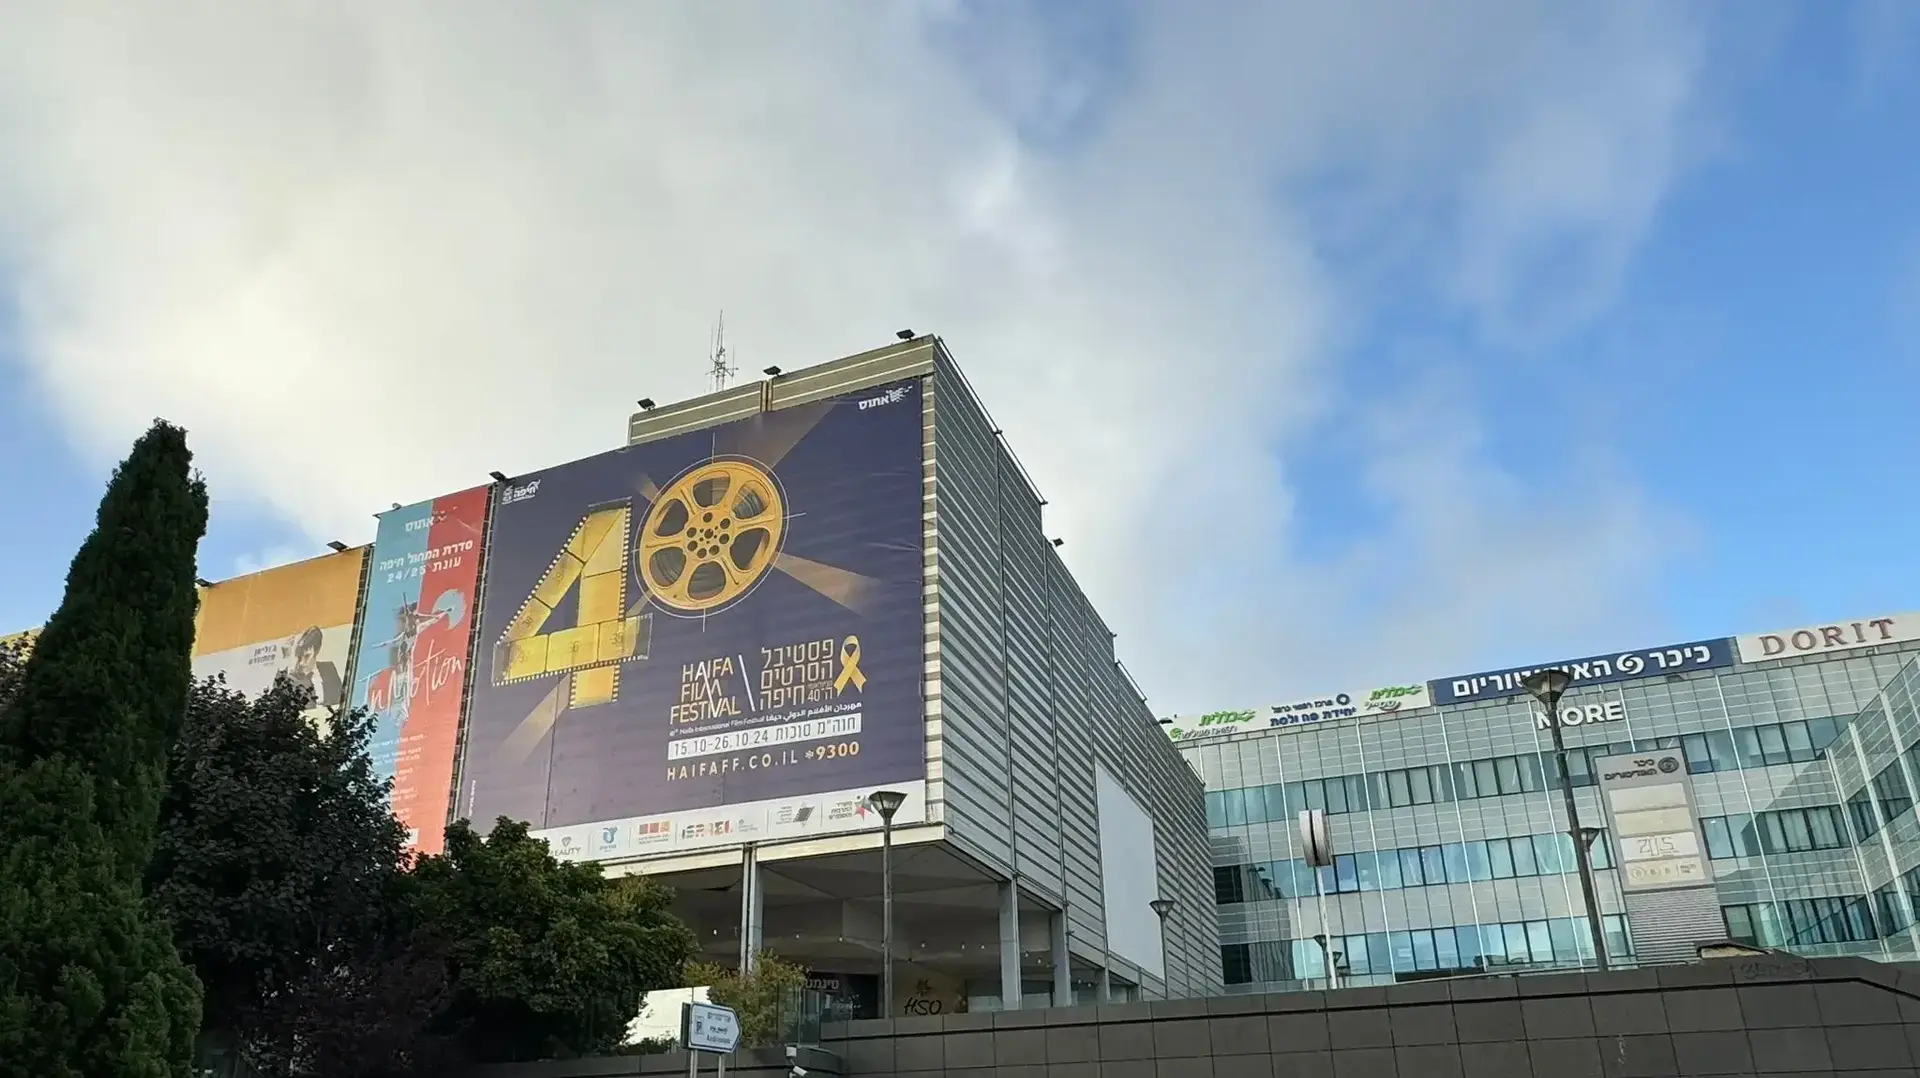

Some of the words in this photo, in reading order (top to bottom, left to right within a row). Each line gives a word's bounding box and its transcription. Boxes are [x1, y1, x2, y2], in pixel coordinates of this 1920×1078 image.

[859, 395, 889, 410] אתוס
[405, 516, 434, 532] אתוס
[408, 549, 440, 564] המחול
[443, 540, 473, 555] סדרת
[380, 556, 404, 571] חיפה
[432, 557, 462, 572] עונת
[388, 565, 426, 583] 24/25
[1758, 618, 1894, 656] DORIT
[761, 638, 834, 669] פסטיבל
[1649, 645, 1711, 668] כיכר
[682, 656, 734, 683] HAIFA
[761, 659, 833, 690] הסרטים
[760, 684, 805, 711] חיפה
[669, 696, 742, 725] FESTIVAL
[1322, 707, 1356, 719] יחידת
[817, 717, 855, 736] חוה"מ
[1270, 714, 1299, 726] ולסת
[775, 723, 811, 741] סוכות
[674, 729, 769, 756] 15.10-26.10.24
[667, 750, 798, 781] HAIFAFF.CO.IL
[904, 997, 942, 1015] HSO
